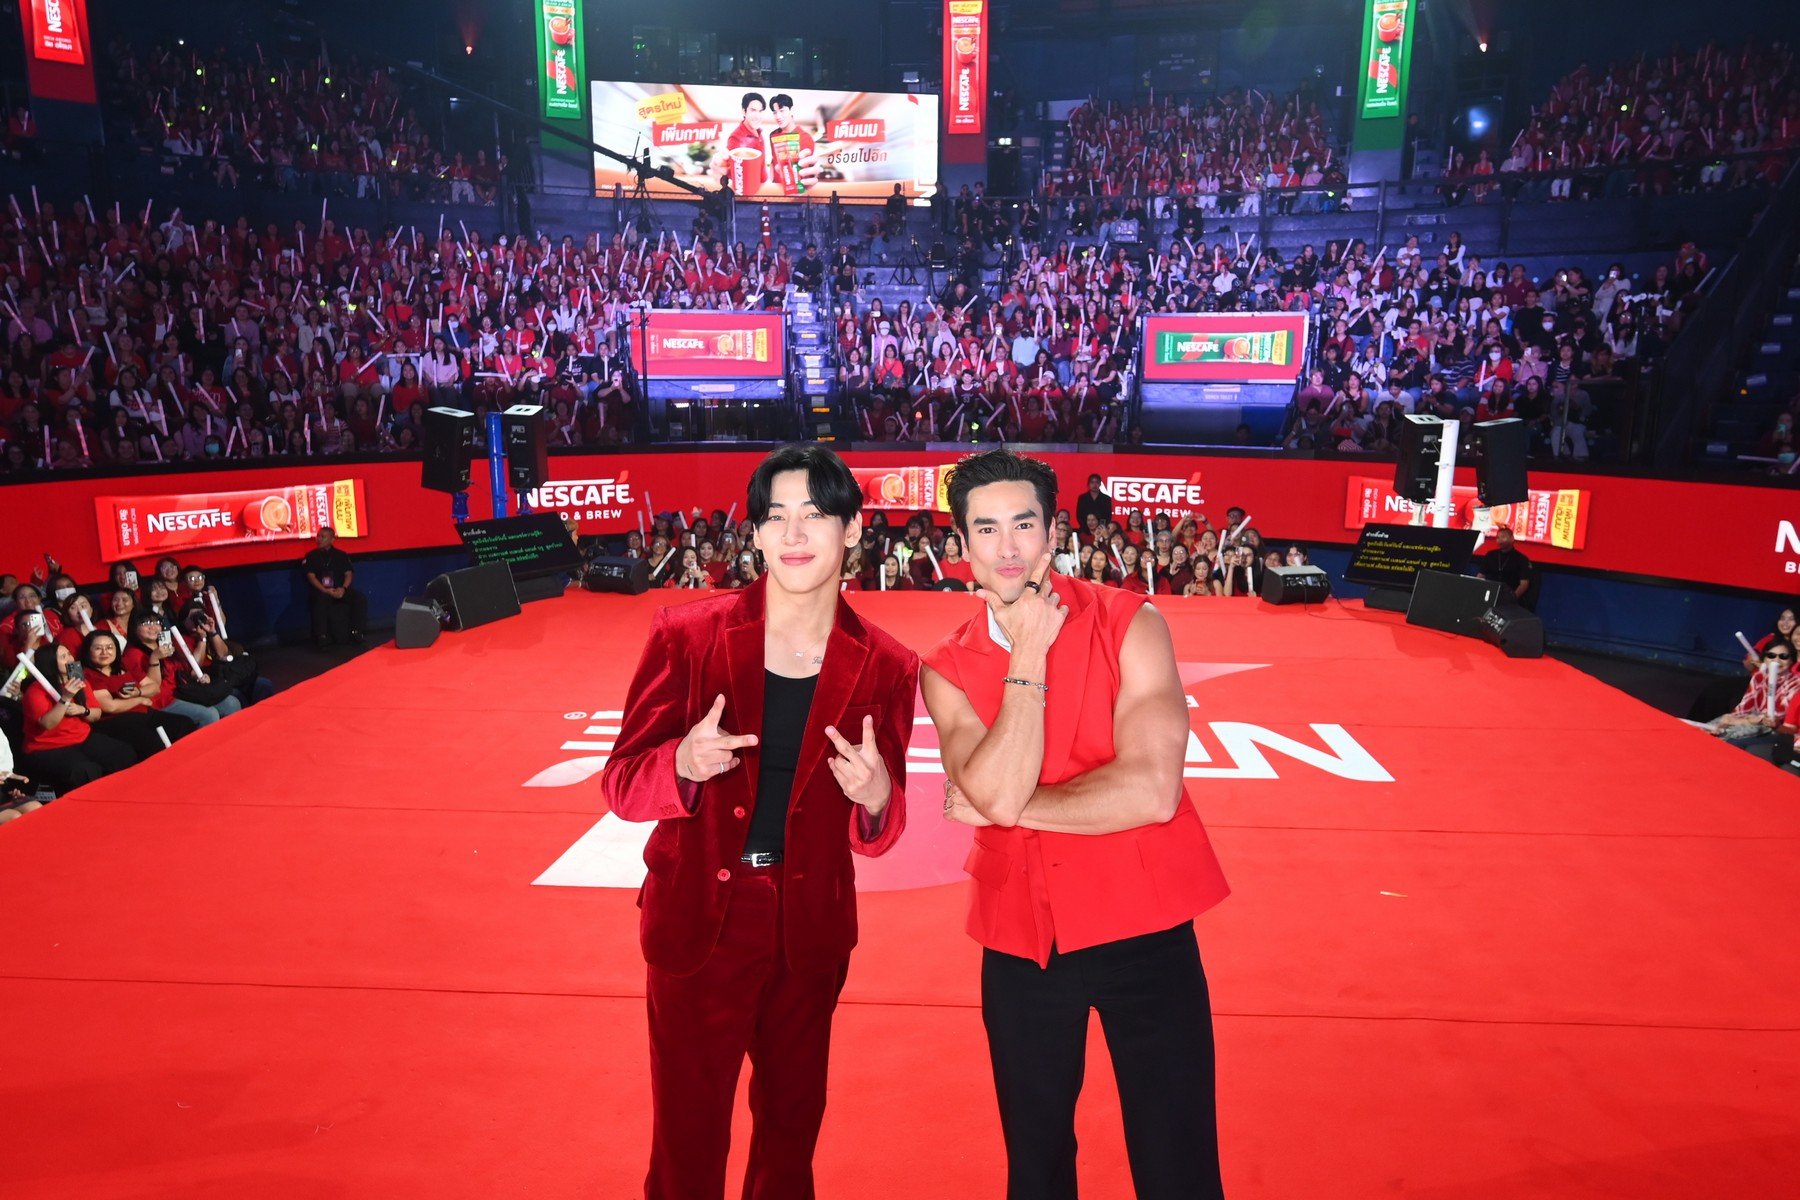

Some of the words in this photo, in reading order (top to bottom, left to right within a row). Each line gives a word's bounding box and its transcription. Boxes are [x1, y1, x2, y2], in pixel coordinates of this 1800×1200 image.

[638, 97, 683, 119] สูตรใหม่
[661, 124, 718, 142] เพิ่มกาแฟ
[834, 121, 878, 139] เติมนม
[828, 148, 887, 164] อร่อยไปอีก
[315, 487, 330, 529] NESCAF
[574, 511, 581, 520] &
[586, 509, 622, 520] BREW
[1143, 508, 1150, 516] &
